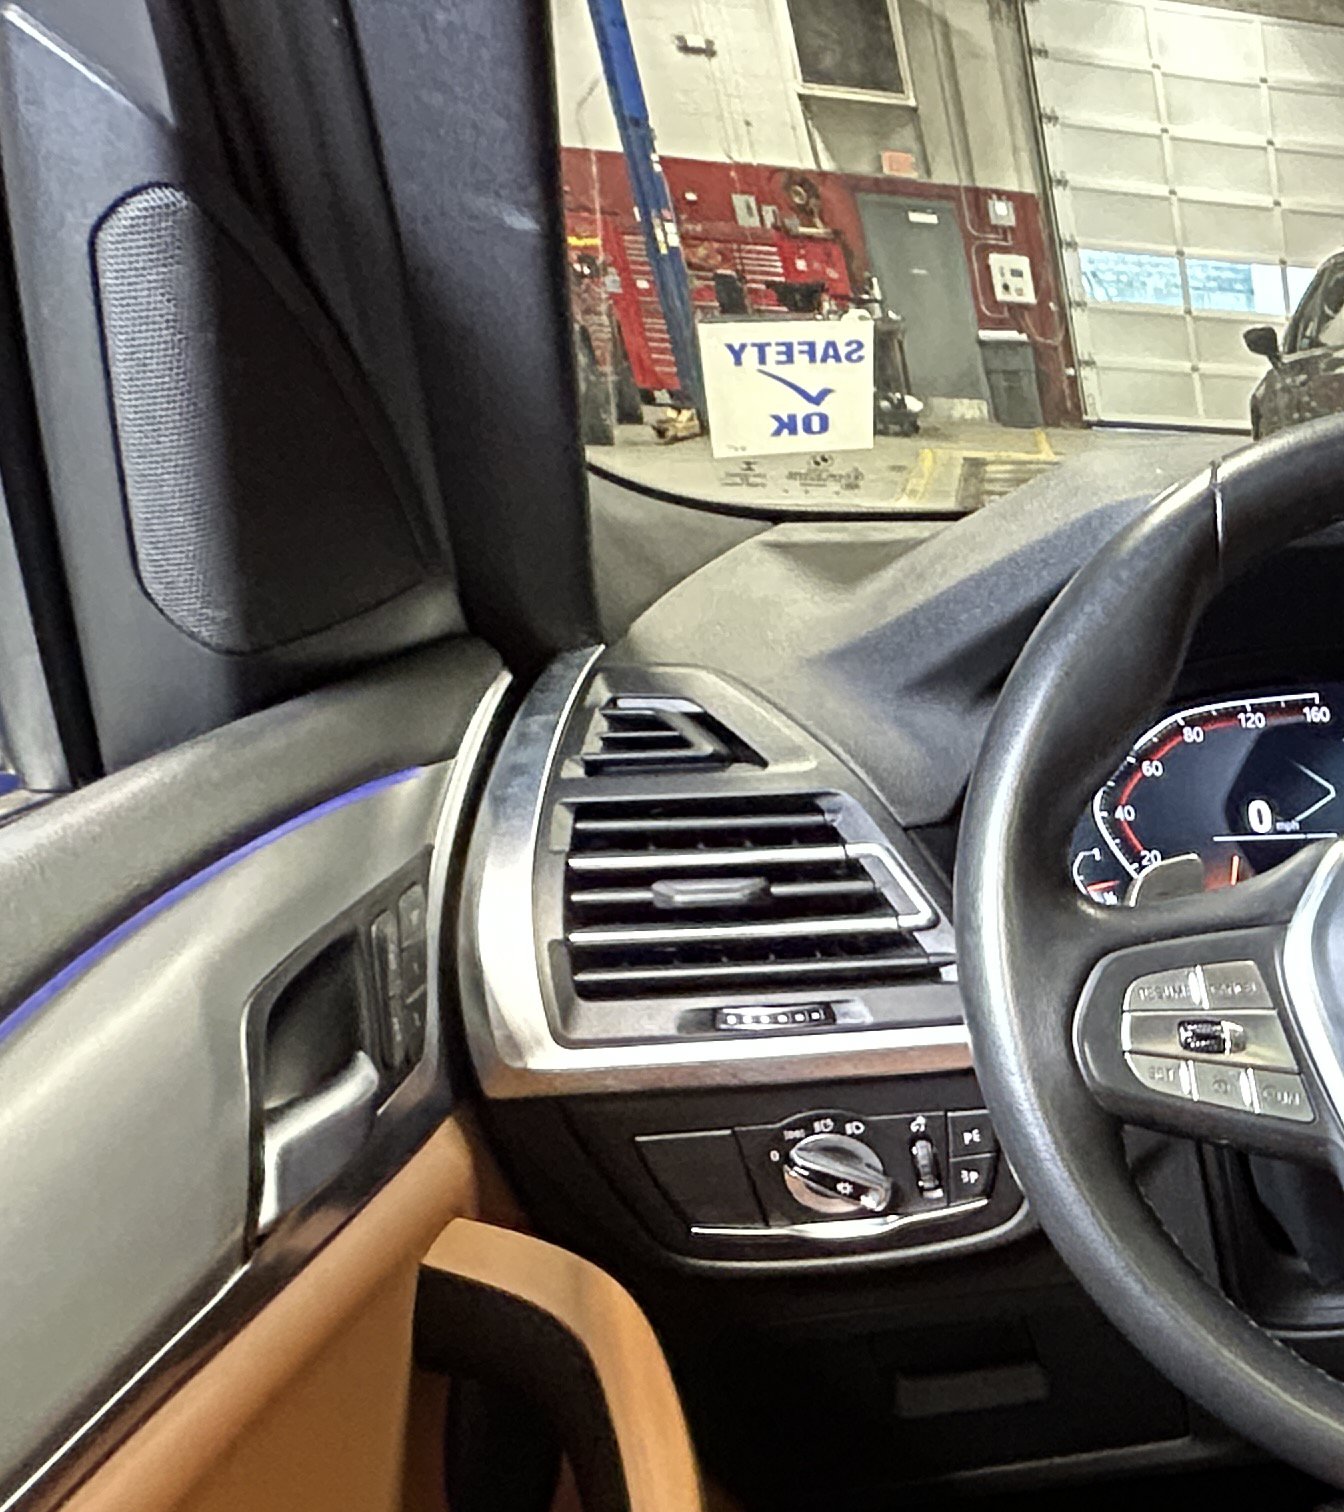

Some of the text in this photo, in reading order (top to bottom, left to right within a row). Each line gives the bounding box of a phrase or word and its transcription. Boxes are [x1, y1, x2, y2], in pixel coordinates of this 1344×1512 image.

[1237, 712, 1266, 729] 120
[1302, 706, 1331, 722] 160
[1182, 727, 1204, 743] 80
[1141, 760, 1164, 777] 60
[1114, 806, 1136, 821] 40
[1248, 799, 1300, 834] 0 mph
[1140, 849, 1162, 866] 20
